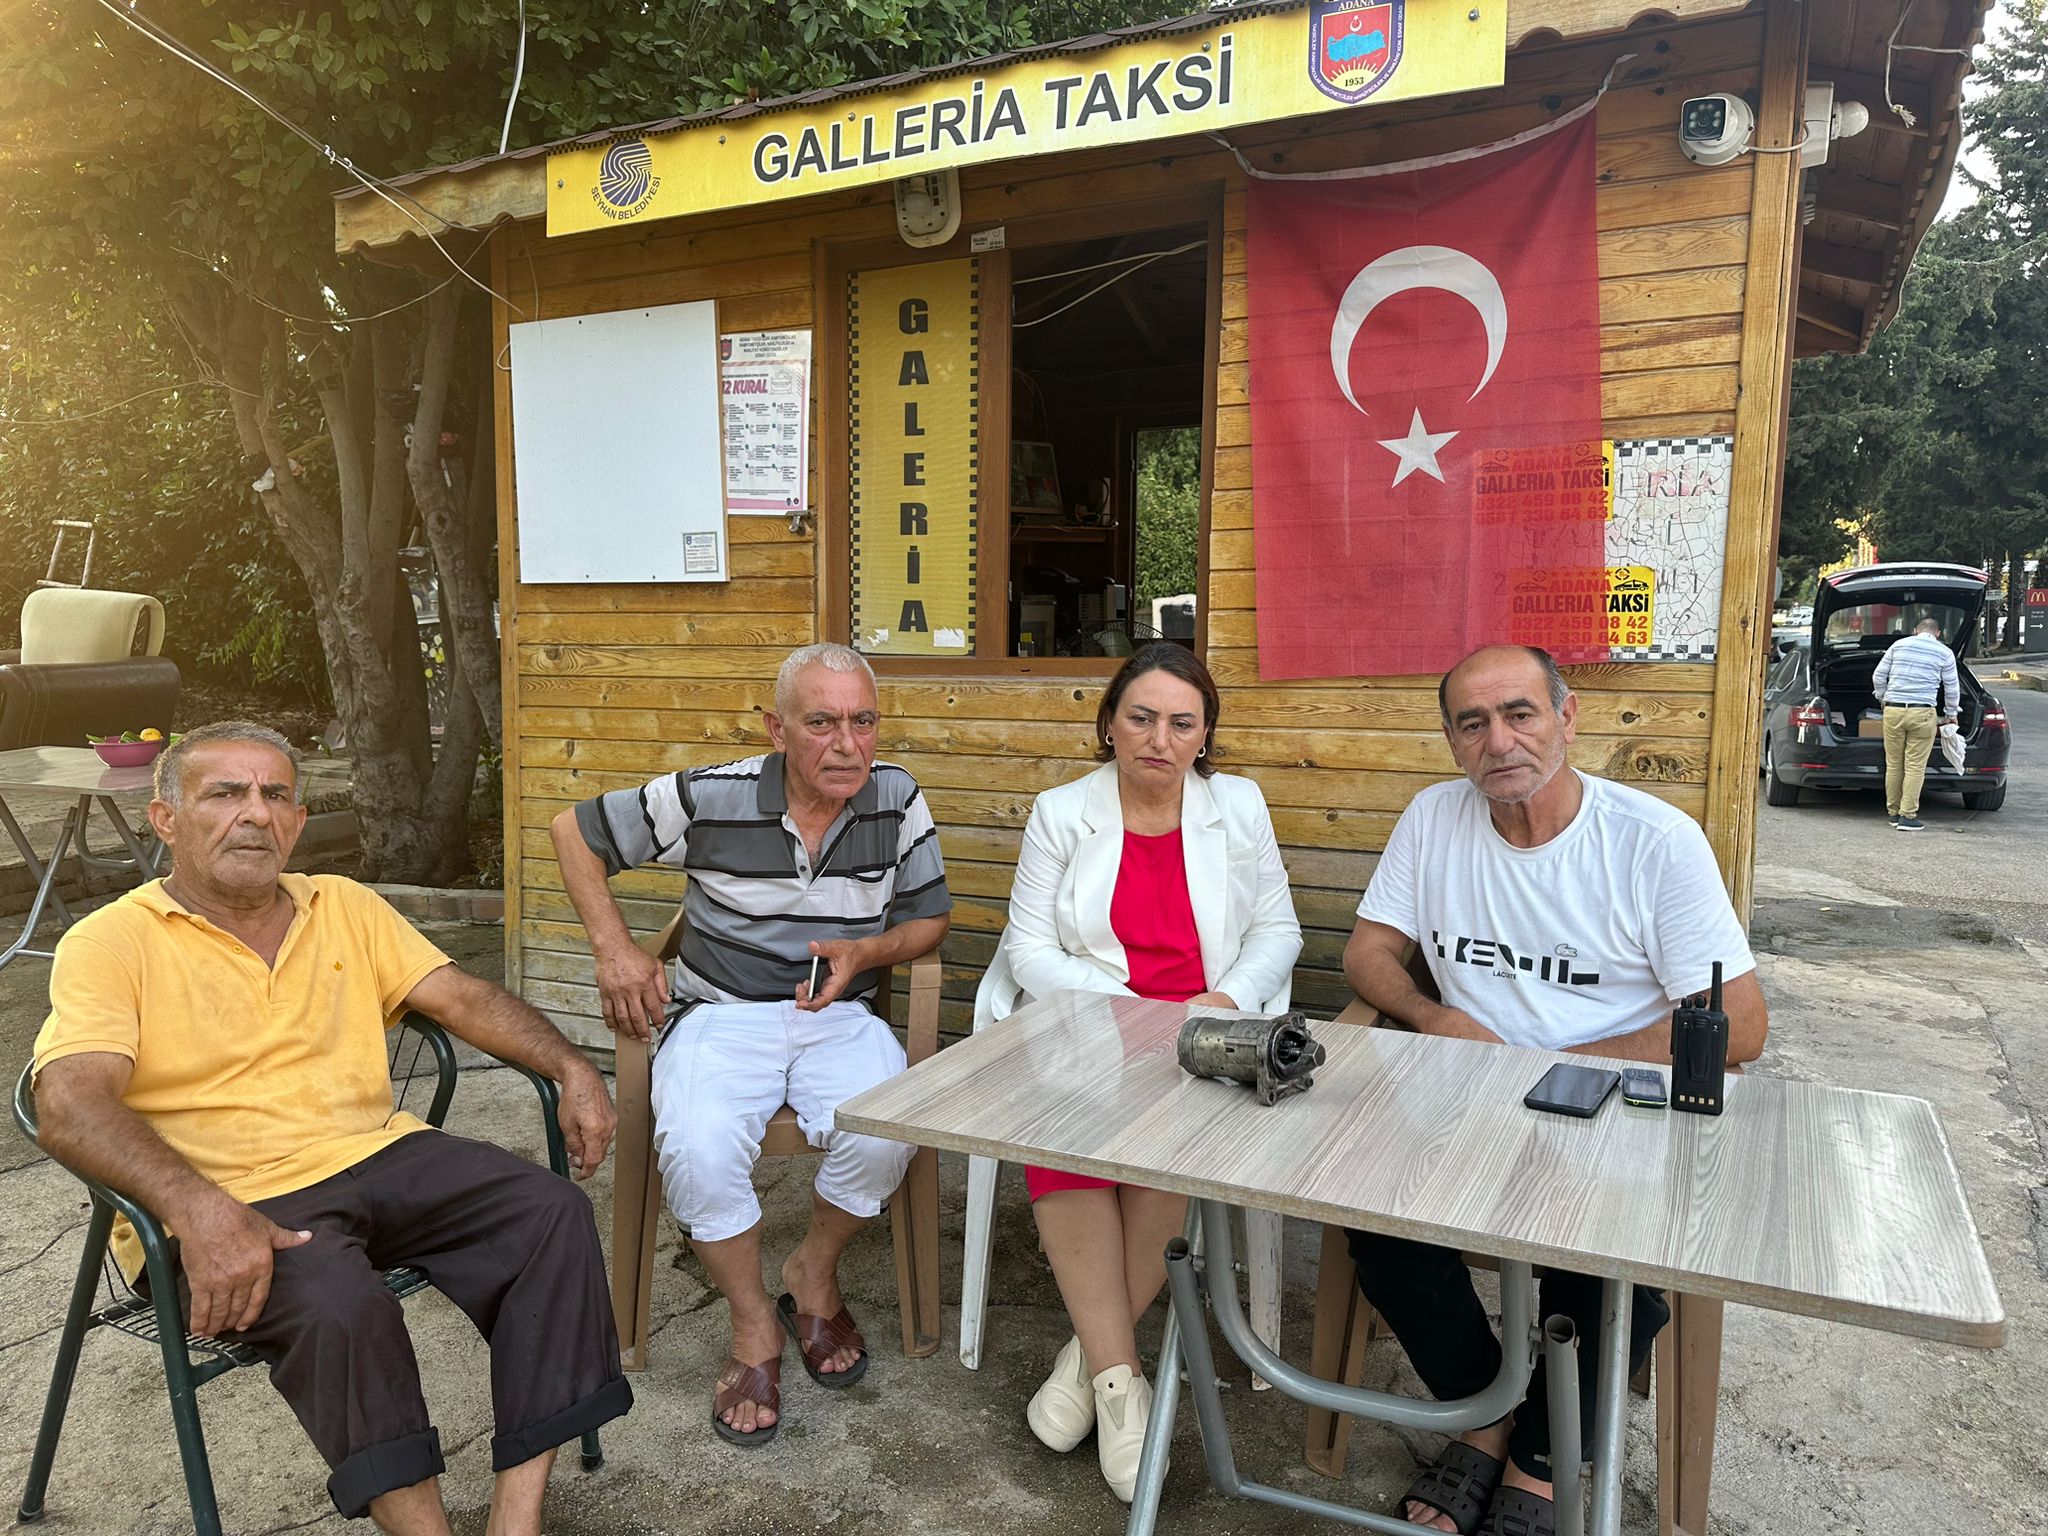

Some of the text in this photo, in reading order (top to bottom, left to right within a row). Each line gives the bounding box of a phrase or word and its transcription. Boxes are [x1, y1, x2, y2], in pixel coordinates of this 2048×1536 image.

[1338, 0, 1375, 11] ADANA
[1345, 77, 1364, 87] 1953
[754, 35, 1232, 182] GALLERİA TAKSİ
[591, 186, 618, 219] SEYHAN
[733, 378, 768, 395] KURAL
[1511, 455, 1575, 472] ADANA
[1476, 471, 1556, 495] GALLERIA
[1476, 490, 1609, 511] 0322 459 08 42
[1522, 509, 1554, 522] 330
[1588, 506, 1609, 519] 63
[1550, 579, 1612, 593] ADANA
[1512, 595, 1594, 614] GALLERIA
[1512, 616, 1554, 630] 0322
[1560, 616, 1593, 630] 459
[1600, 616, 1620, 630] 08
[1626, 616, 1648, 629] 42
[1512, 631, 1647, 645] 0501 330 64 63
